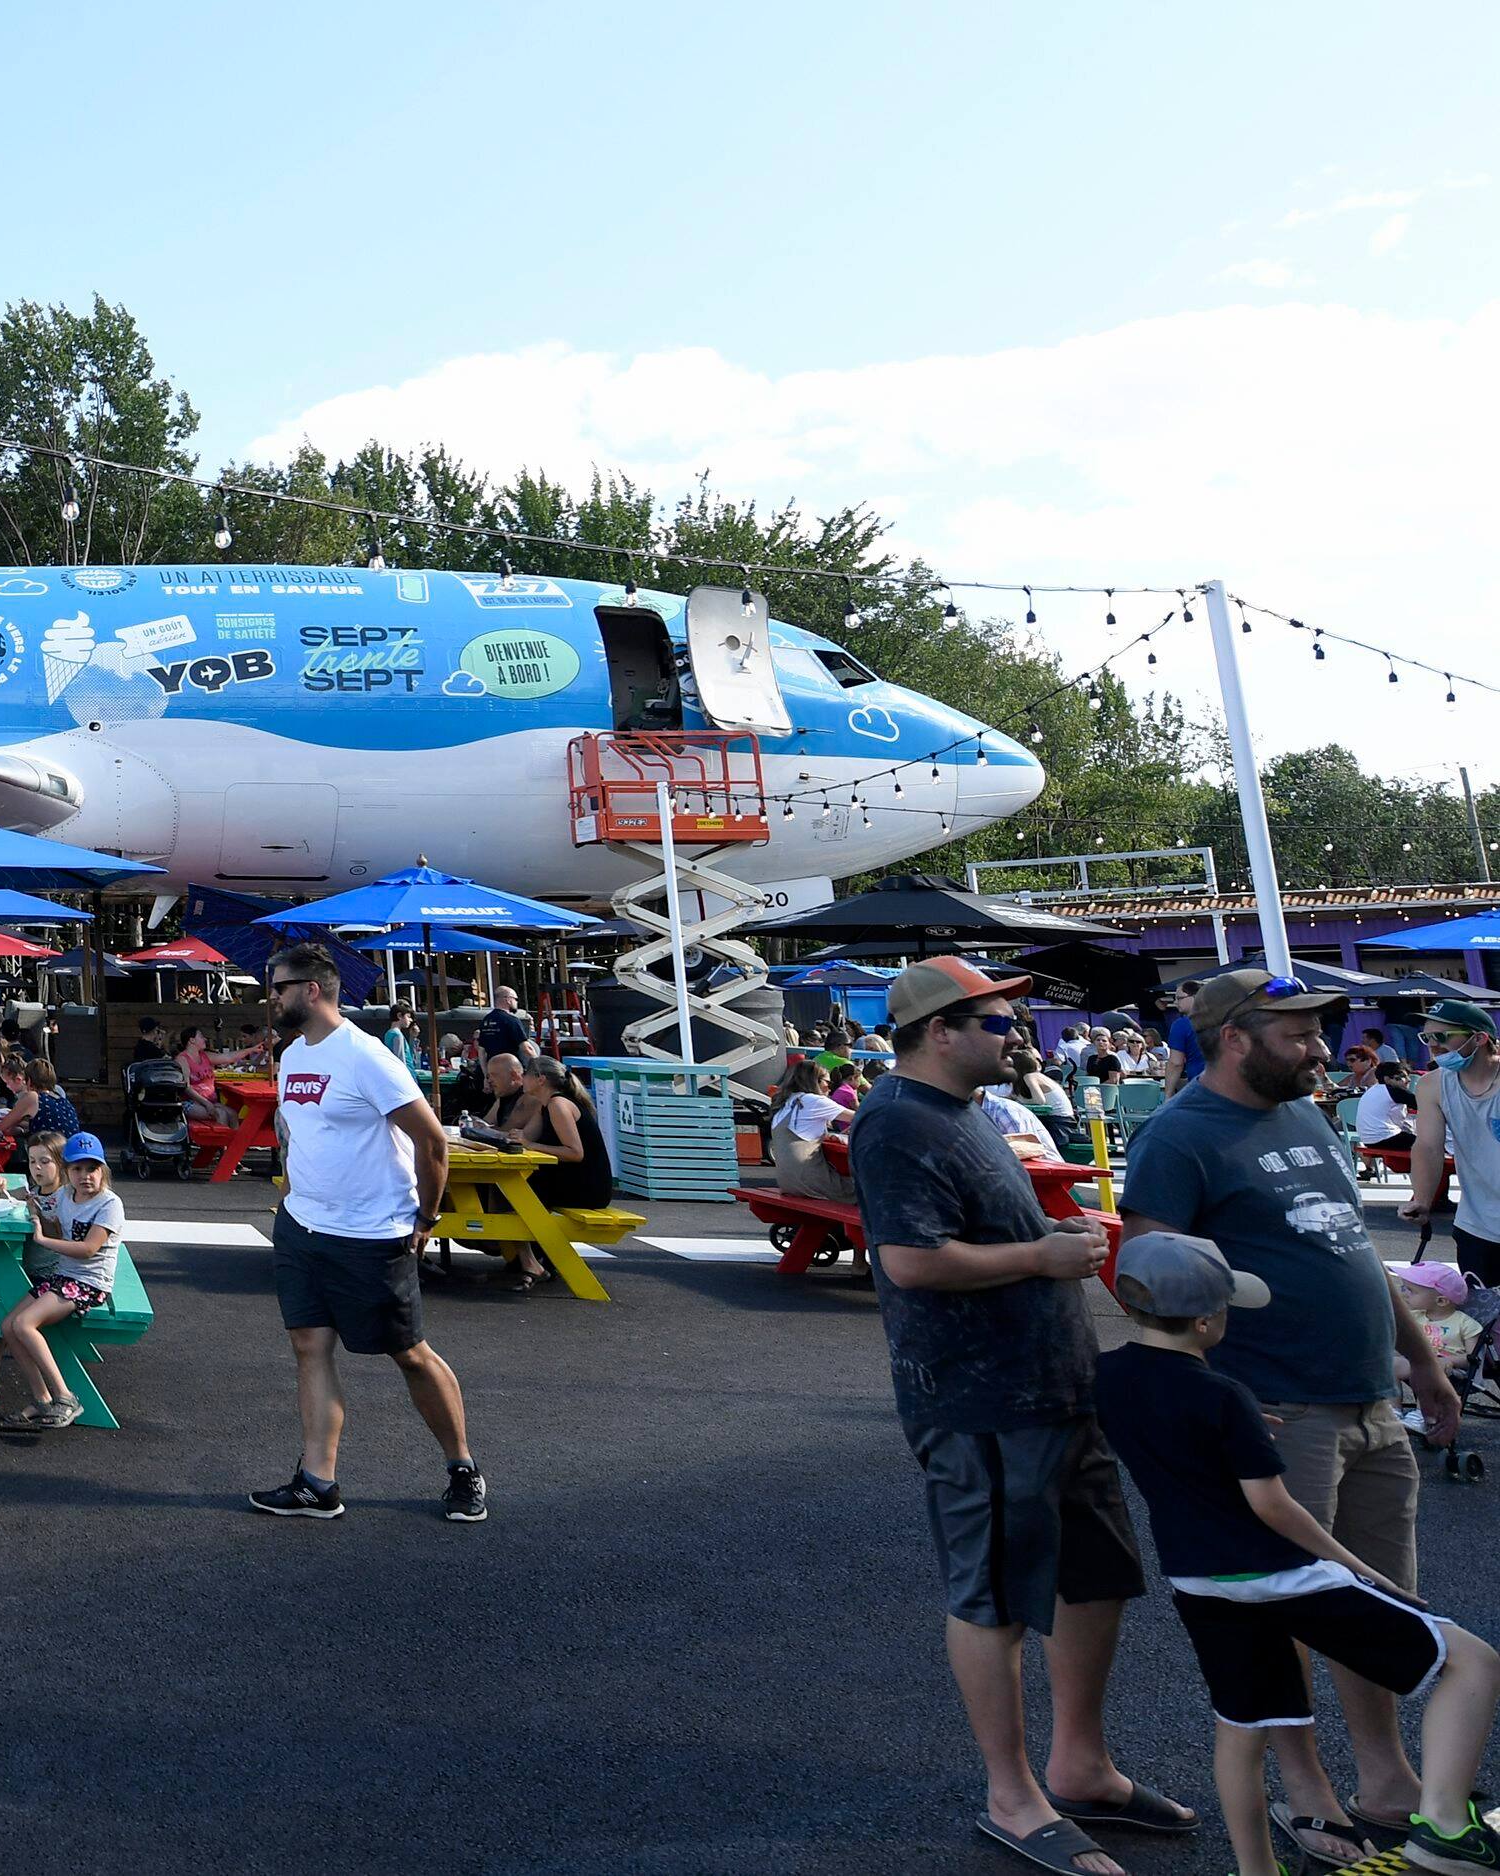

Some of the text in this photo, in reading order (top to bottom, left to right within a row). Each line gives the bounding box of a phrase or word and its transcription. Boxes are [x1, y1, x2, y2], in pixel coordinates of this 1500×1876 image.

[159, 570, 360, 584] UN ATTERRISSAGE
[161, 585, 364, 595] TOUT EN SAVEUR
[216, 617, 276, 629] CONSIGNES
[5, 622, 25, 653] VERS
[218, 630, 231, 640] DE
[299, 626, 418, 647] SEPT
[298, 629, 424, 677] trente
[484, 640, 550, 663] BIENVENUE
[7, 657, 22, 674] LE
[146, 651, 274, 693] YQB
[497, 662, 507, 685] À
[508, 663, 542, 684] BORD
[304, 669, 424, 692] SEPT
